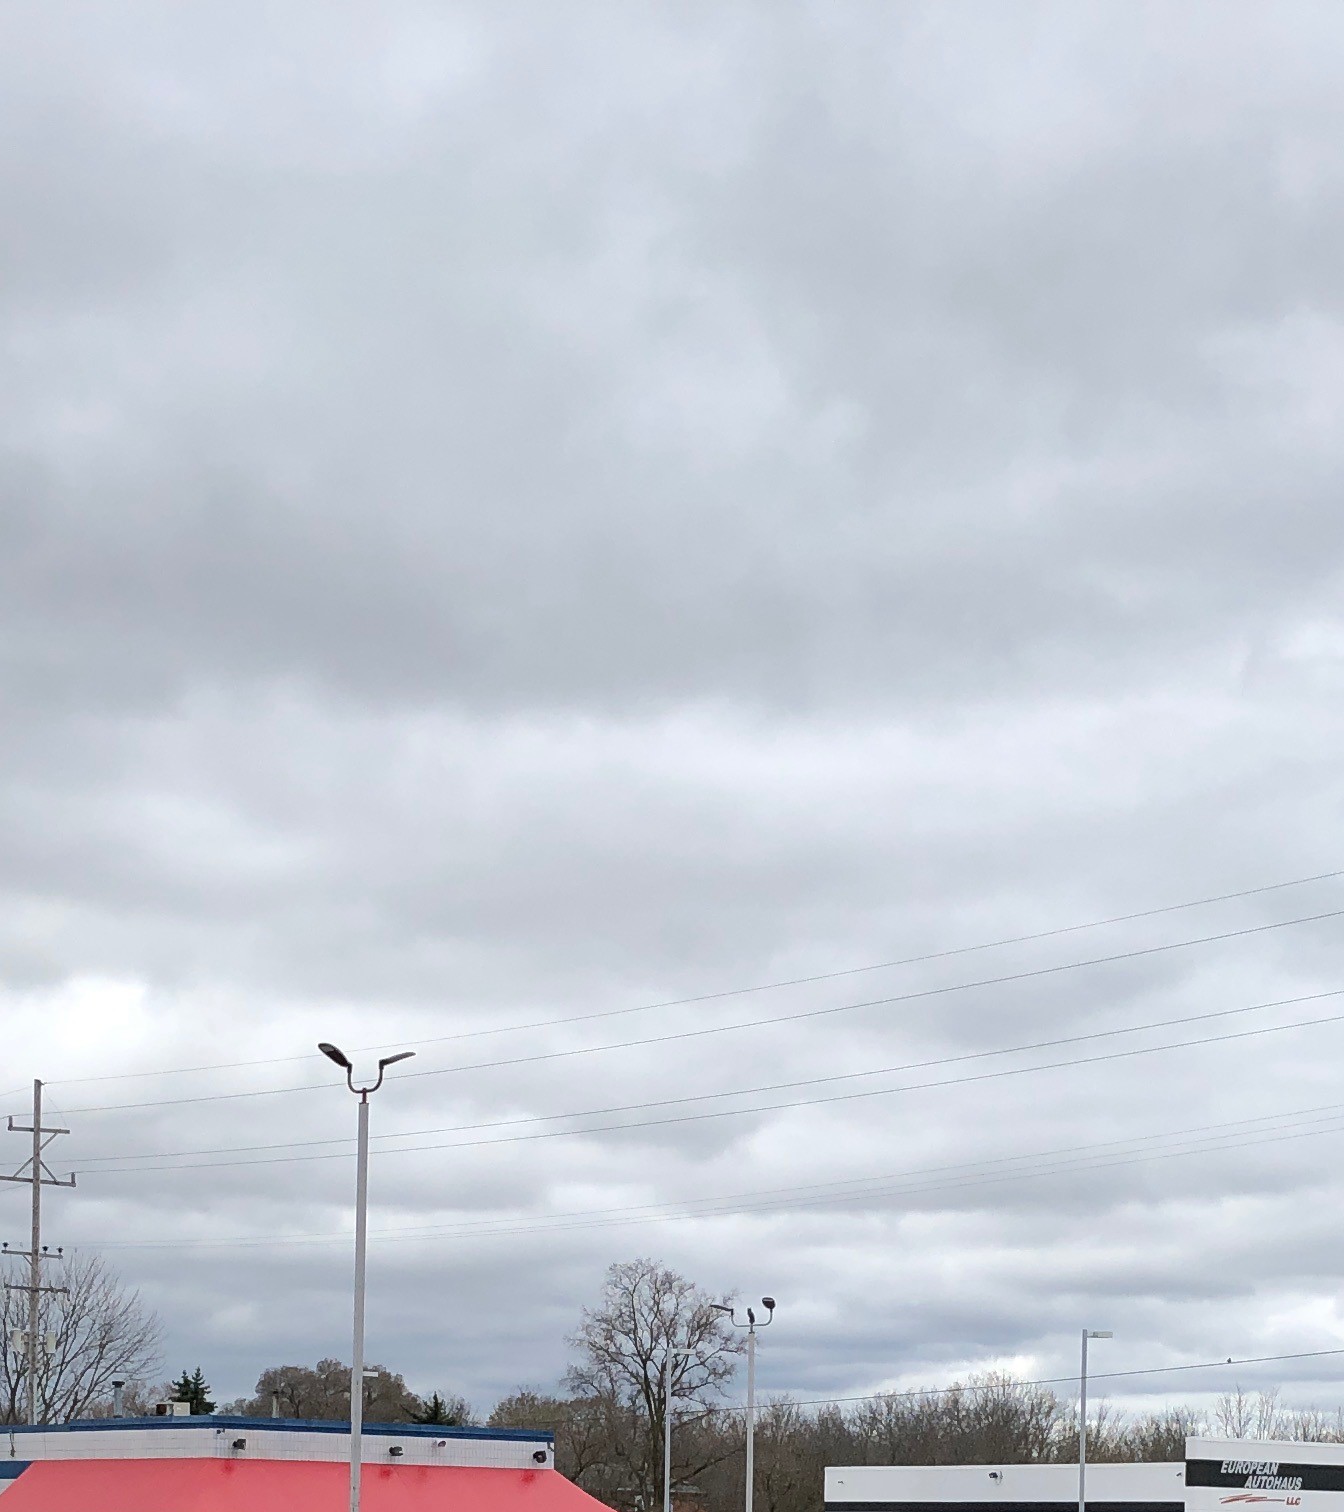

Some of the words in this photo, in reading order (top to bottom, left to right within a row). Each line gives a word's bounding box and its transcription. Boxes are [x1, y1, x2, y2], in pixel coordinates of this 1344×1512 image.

[1220, 1460, 1279, 1475] EUROPEAN
[1244, 1475, 1303, 1490] AUTOHAUS
[1285, 1497, 1302, 1506] LLC
